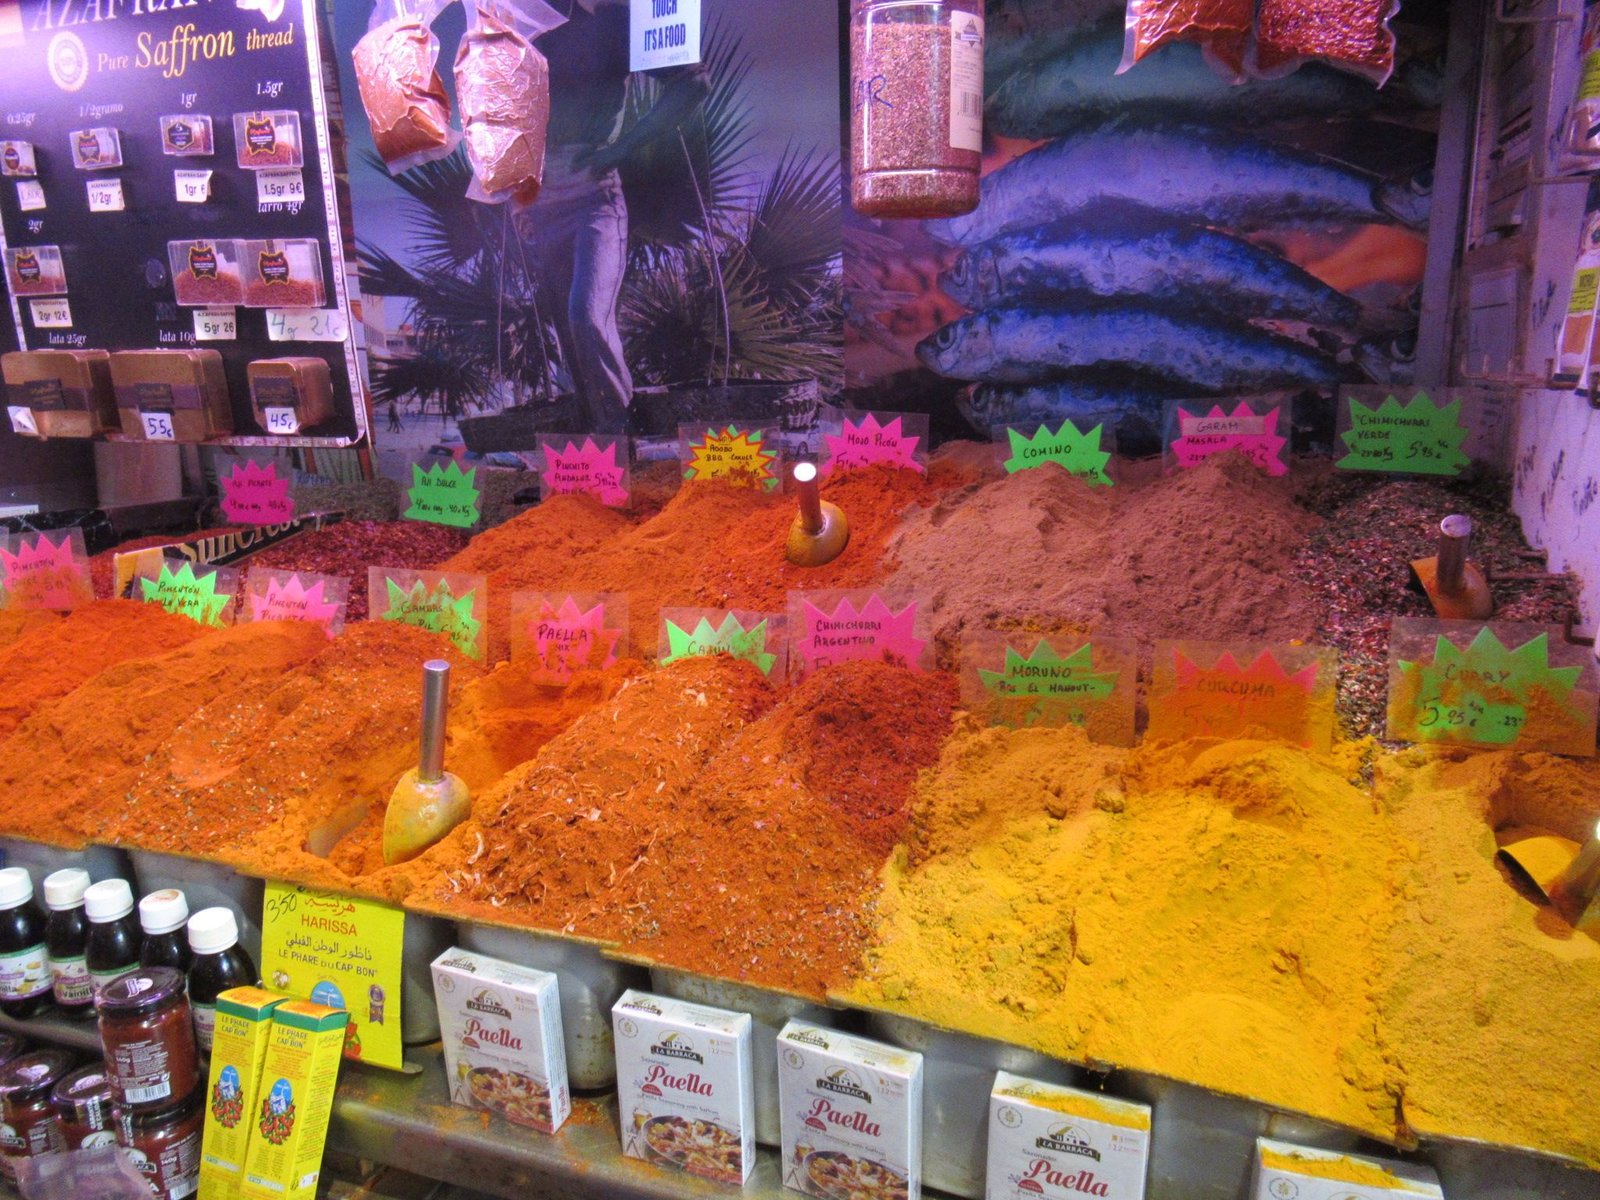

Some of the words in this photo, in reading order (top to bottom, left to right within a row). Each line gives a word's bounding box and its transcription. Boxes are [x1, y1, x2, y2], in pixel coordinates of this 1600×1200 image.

[658, 28, 664, 49] A
[665, 23, 686, 48] FOOD
[97, 52, 129, 72] Pure
[135, 23, 236, 78] Saffron
[246, 24, 294, 51] thread
[257, 81, 284, 98] 1.5gr
[181, 93, 197, 108] 1gr
[80, 103, 124, 119] 1/2gramo
[7, 112, 36, 126] 0.25gr
[184, 184, 197, 197] 1gr
[264, 183, 285, 197] 1.5gr
[91, 191, 112, 205] 1/2gr
[28, 219, 43, 233] 2gr
[39, 311, 52, 323] 2gr
[54, 311, 68, 321] 12€
[204, 322, 219, 335] 5gr
[223, 321, 234, 333] 26
[49, 332, 64, 344] lata
[67, 333, 86, 346] 25gr
[159, 330, 177, 343] lata
[1023, 444, 1072, 459] COMINO
[537, 623, 588, 642] PAELLA
[301, 914, 358, 937] HARISSA
[278, 948, 289, 958] LE
[291, 951, 319, 967] PHARE
[335, 961, 354, 973] CAP
[465, 1018, 523, 1050] Paella
[666, 1049, 697, 1060] BARRACA
[644, 1064, 714, 1097] Paella
[832, 1083, 865, 1097] BARRACA
[808, 1098, 881, 1137] Paella
[1042, 1140, 1053, 1149] LA
[1055, 1142, 1094, 1157] BARRACA
[1023, 1159, 1110, 1197] Paella
